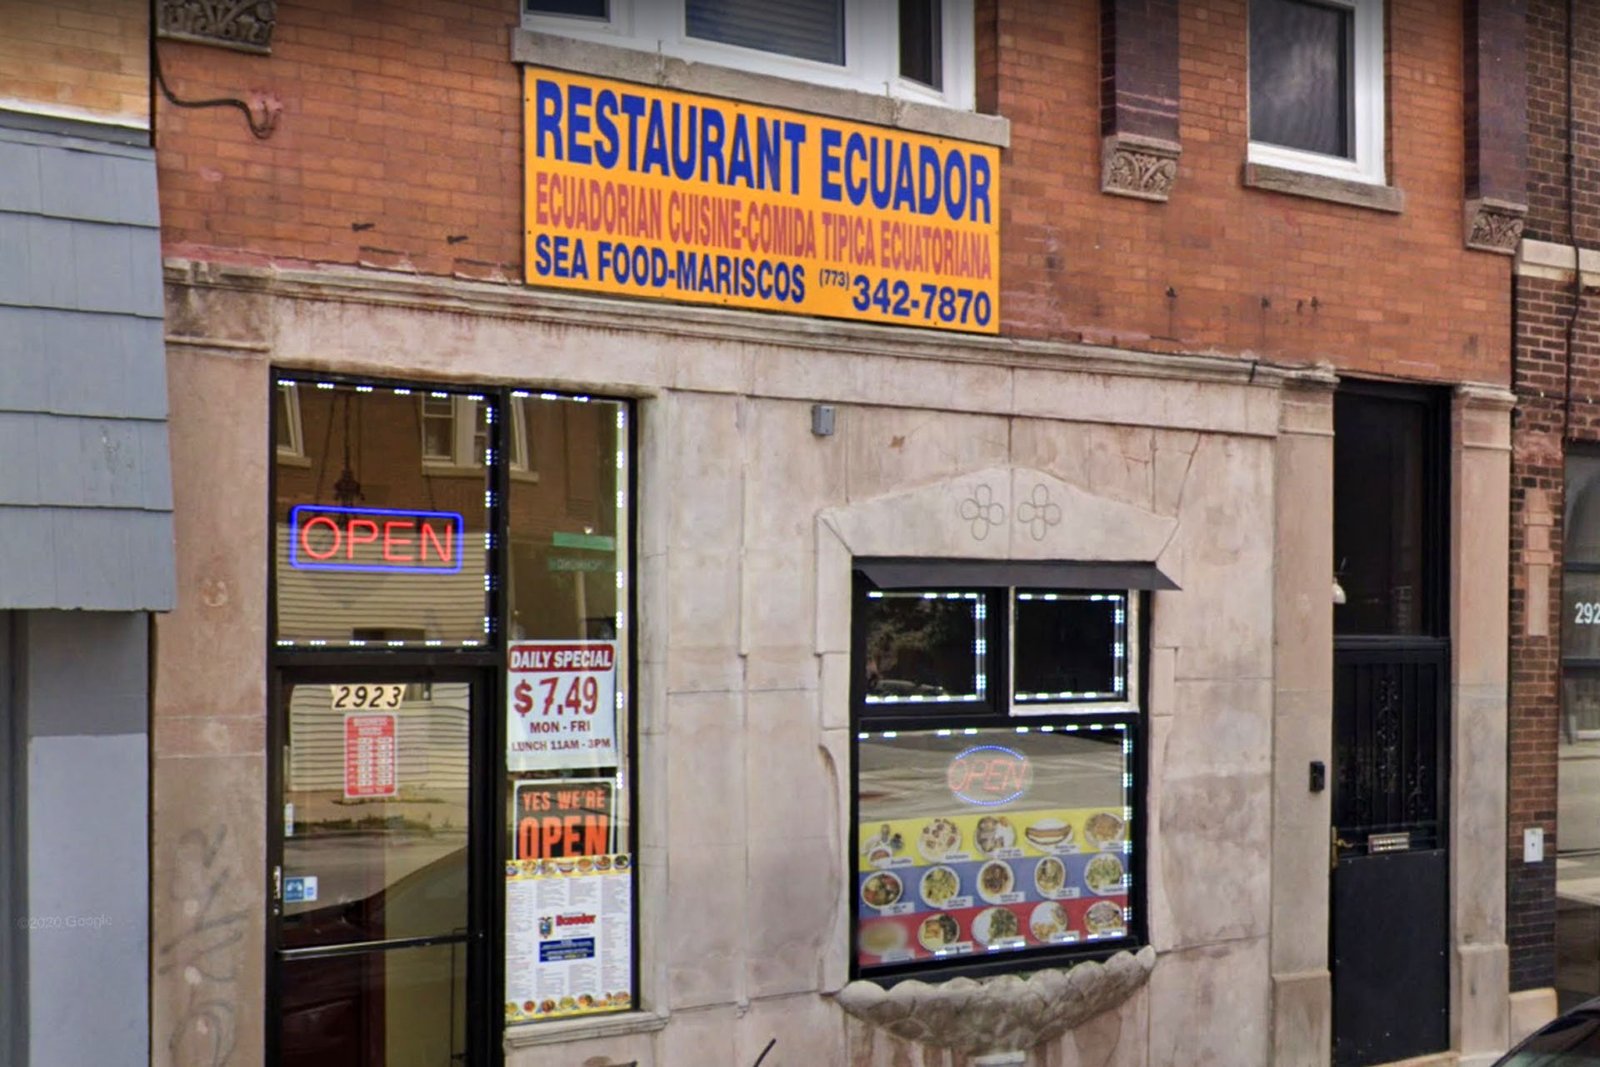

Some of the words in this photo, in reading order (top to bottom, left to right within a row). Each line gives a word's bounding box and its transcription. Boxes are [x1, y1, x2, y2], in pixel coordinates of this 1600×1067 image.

[535, 79, 806, 196] RESTAURANT
[820, 127, 991, 224] ECUADOR
[536, 171, 662, 241] ECUADORIAN
[668, 190, 817, 260] CUISINE-COMIDA
[822, 211, 876, 267] TIPICA
[880, 219, 992, 280] ECUATORIANA
[535, 233, 588, 280] SEA
[597, 240, 806, 304] FOOD-MARISCOS
[819, 268, 850, 291] (773)
[852, 274, 992, 327] 342-7870
[301, 516, 453, 562] OPEN
[510, 651, 552, 668] DAILY
[553, 650, 612, 668] SPECIAL
[335, 686, 402, 708] 2923
[530, 721, 560, 734] MON
[570, 720, 591, 732] FRI
[512, 741, 547, 752] LUNCH
[550, 739, 579, 750] 11AM
[588, 738, 611, 748] 3PM
[947, 758, 1028, 792] OPEN
[522, 791, 551, 811] YES
[557, 788, 605, 809] WE'RE
[518, 815, 608, 860] OPEN
